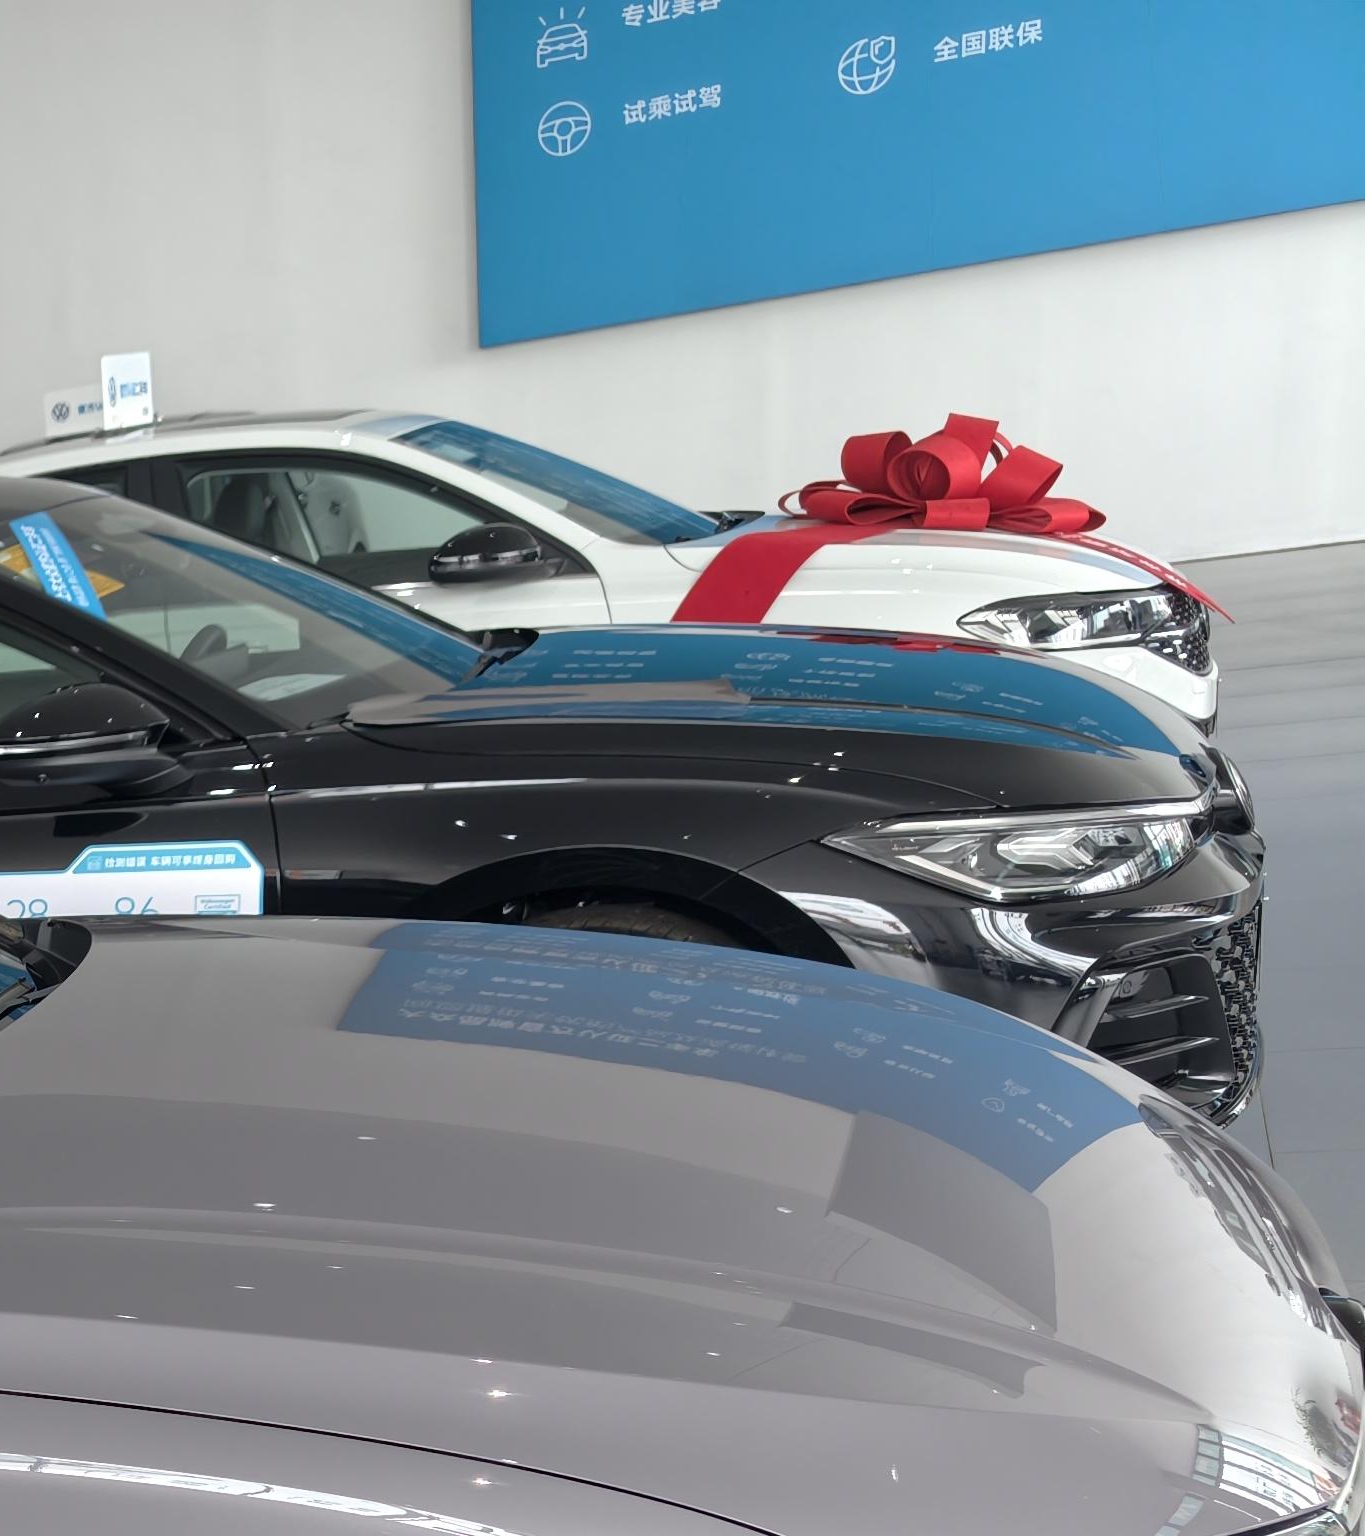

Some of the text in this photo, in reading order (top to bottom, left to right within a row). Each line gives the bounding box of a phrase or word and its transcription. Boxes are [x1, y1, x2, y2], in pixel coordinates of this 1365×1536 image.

[932, 18, 1044, 64] 全国联保
[622, 83, 722, 125] 试乘试驾
